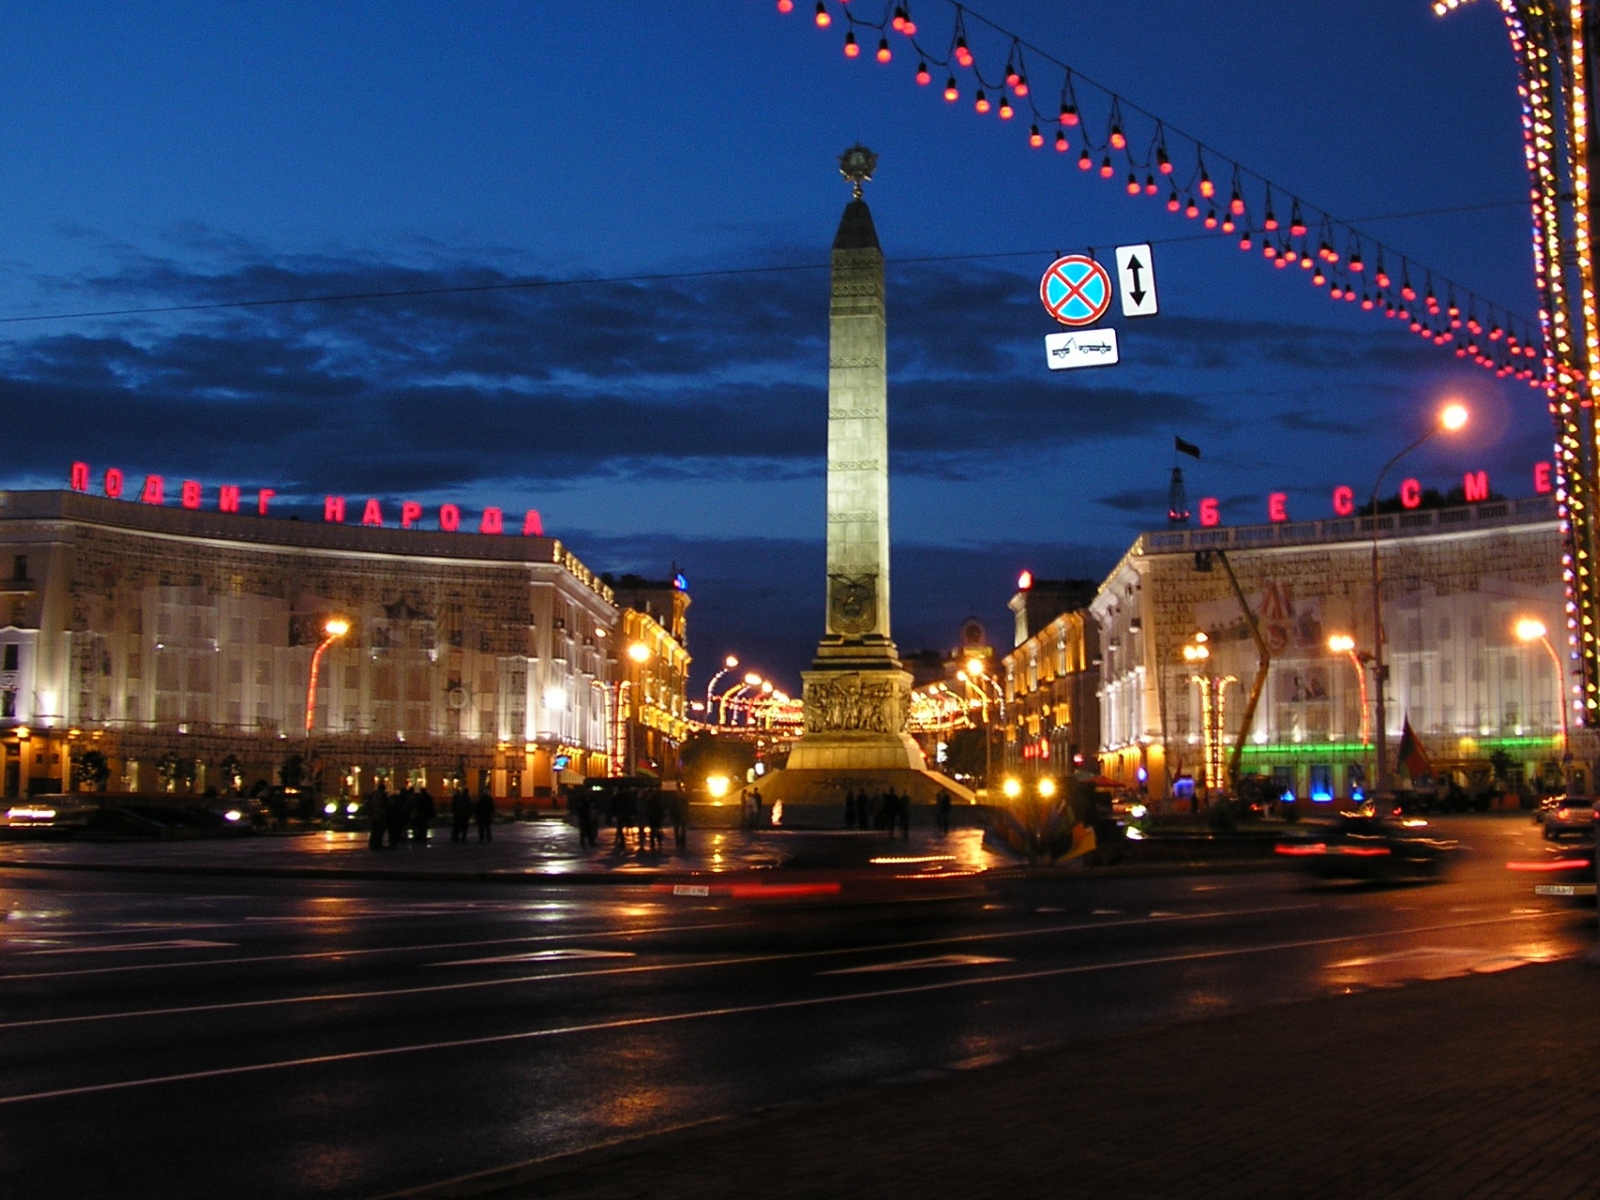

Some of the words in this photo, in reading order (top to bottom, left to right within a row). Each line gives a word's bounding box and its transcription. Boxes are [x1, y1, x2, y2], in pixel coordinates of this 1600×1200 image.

[71, 462, 275, 516] ПОДВИГ
[324, 495, 543, 536] НАРОДА
[1199, 461, 1553, 527] БЕССМЕ
